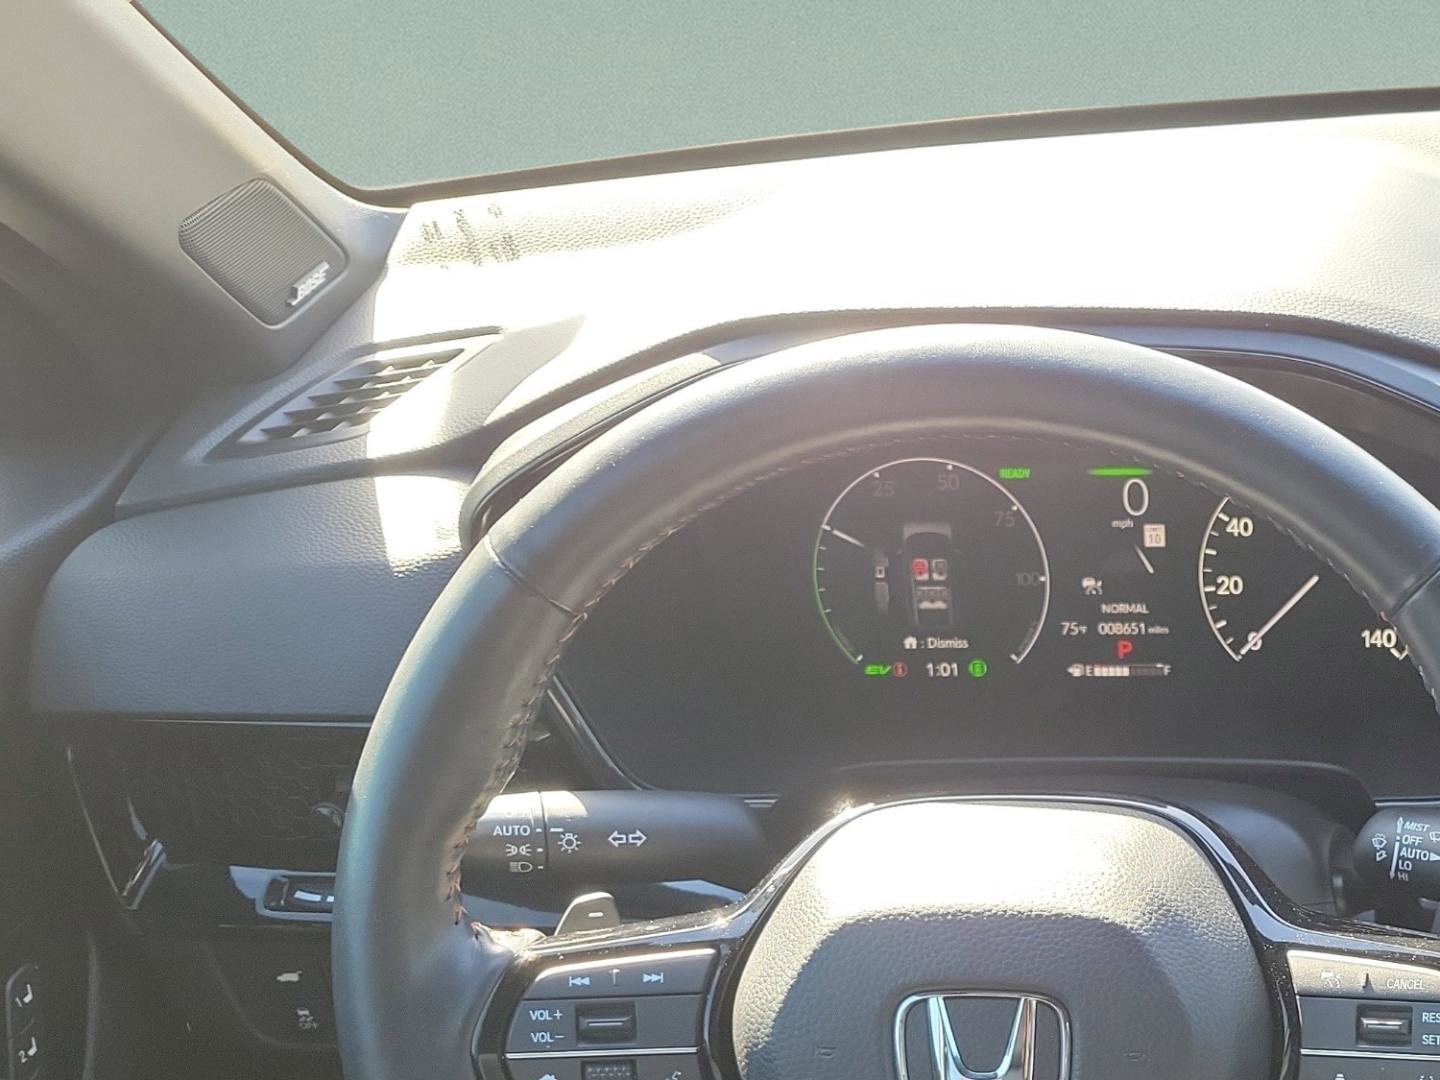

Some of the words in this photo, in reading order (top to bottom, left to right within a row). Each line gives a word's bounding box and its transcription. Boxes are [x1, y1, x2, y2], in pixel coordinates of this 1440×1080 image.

[937, 474, 960, 491] 50
[1122, 478, 1149, 516] 0
[1111, 519, 1134, 529] mph
[1226, 517, 1254, 537] 40
[1148, 533, 1162, 544] 10
[1216, 575, 1244, 595] 20
[1101, 603, 1150, 614] NORMAL
[1097, 622, 1146, 635] 008651
[927, 637, 969, 649] Dismiss
[1361, 629, 1397, 648] 140
[1117, 639, 1133, 659] P
[864, 665, 892, 676] EV
[926, 662, 959, 677] 1:01
[1085, 665, 1093, 677] E
[1163, 665, 1171, 676] F
[492, 825, 531, 836] AUTO
[1403, 821, 1431, 832] MIST
[1402, 834, 1424, 846] OFF
[1399, 847, 1430, 861] AUTO
[1398, 859, 1413, 871] LO
[1397, 871, 1409, 882] HI
[1386, 977, 1426, 990] CANCEL
